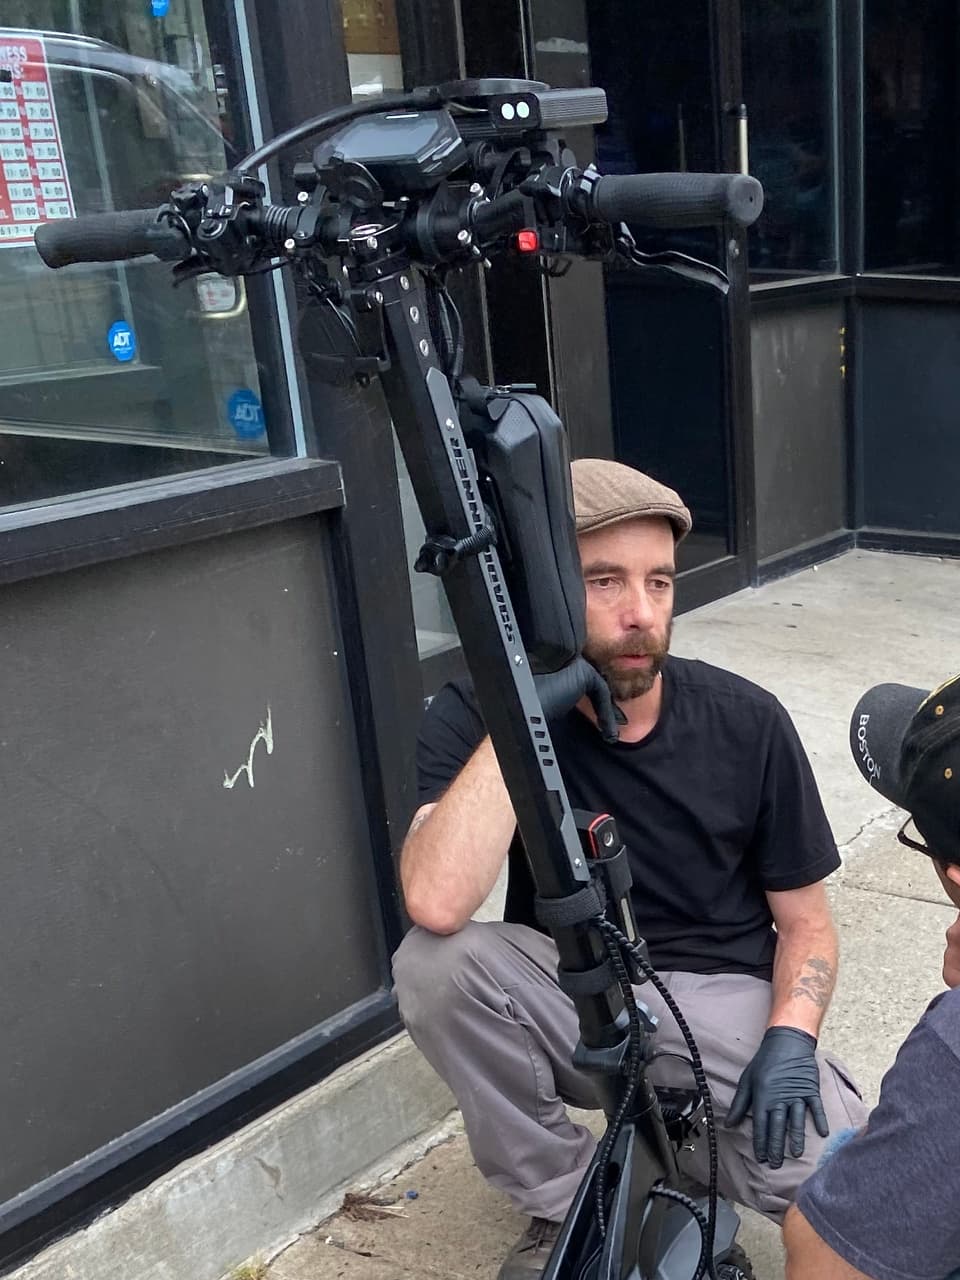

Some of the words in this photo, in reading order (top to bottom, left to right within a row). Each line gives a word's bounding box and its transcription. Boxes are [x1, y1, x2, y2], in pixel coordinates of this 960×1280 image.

[113, 332, 130, 346] ADT
[234, 403, 261, 422] ADT
[857, 714, 881, 780] BOSTON
